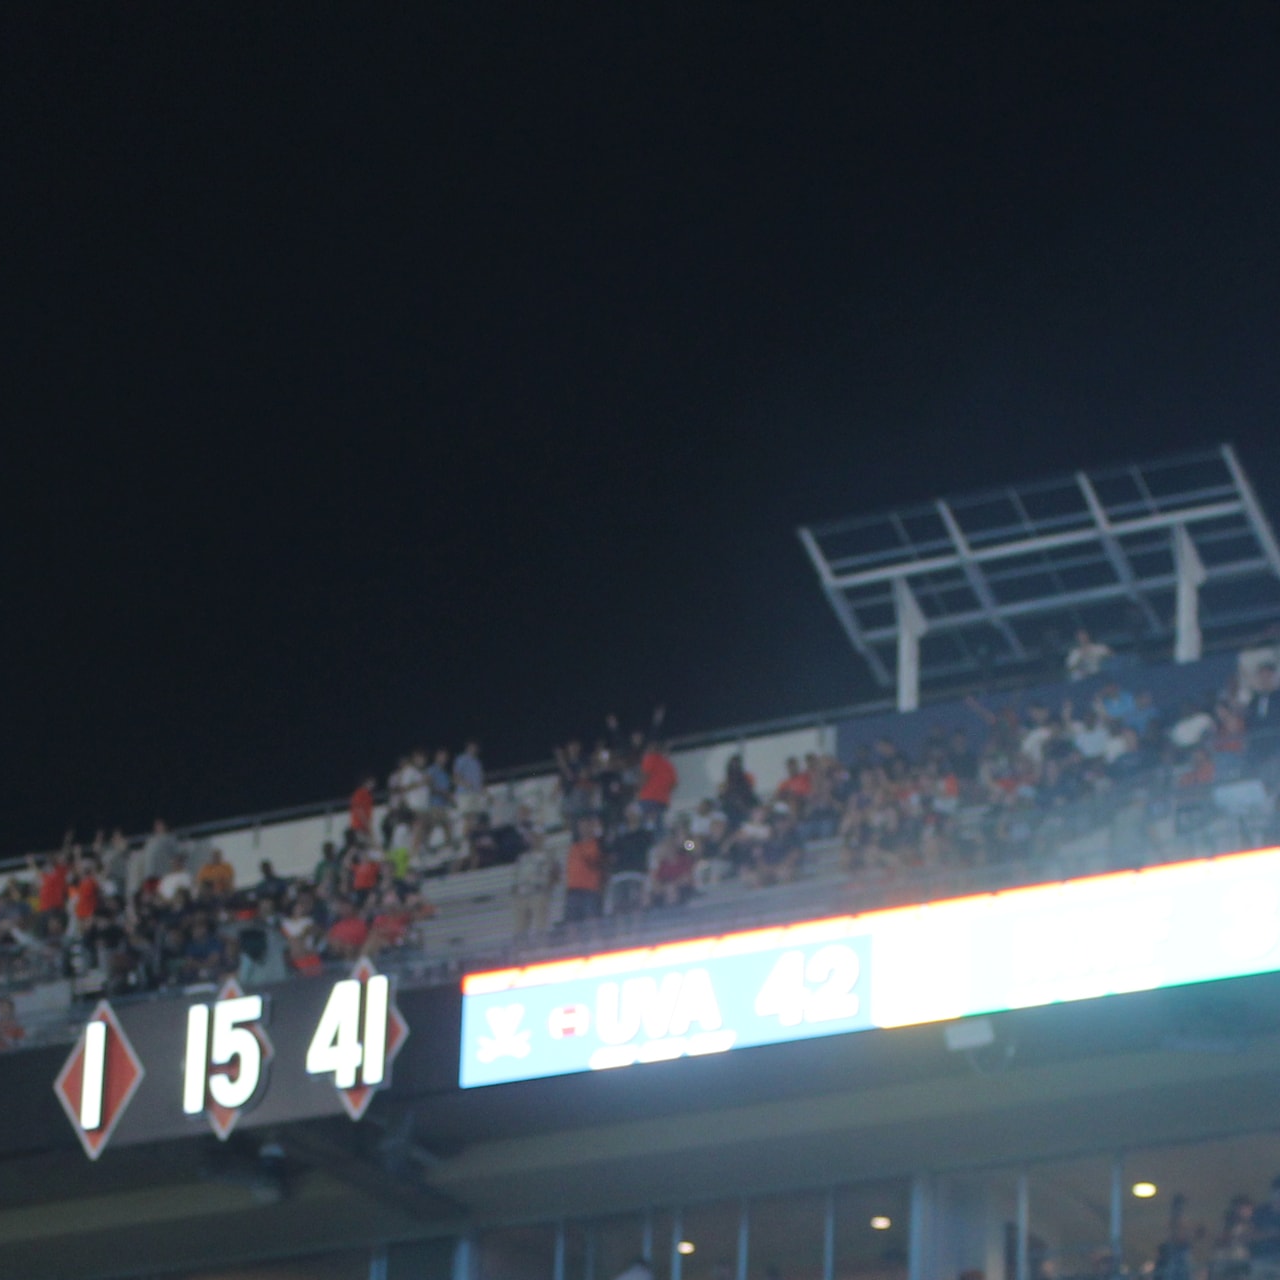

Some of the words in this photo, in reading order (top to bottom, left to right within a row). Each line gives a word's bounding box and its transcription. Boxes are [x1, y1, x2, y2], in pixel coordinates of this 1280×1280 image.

[307, 975, 389, 1088] 41
[595, 968, 722, 1044] UVA
[755, 945, 859, 1026] 42
[80, 1021, 106, 1130] 1
[183, 996, 263, 1116] 15
